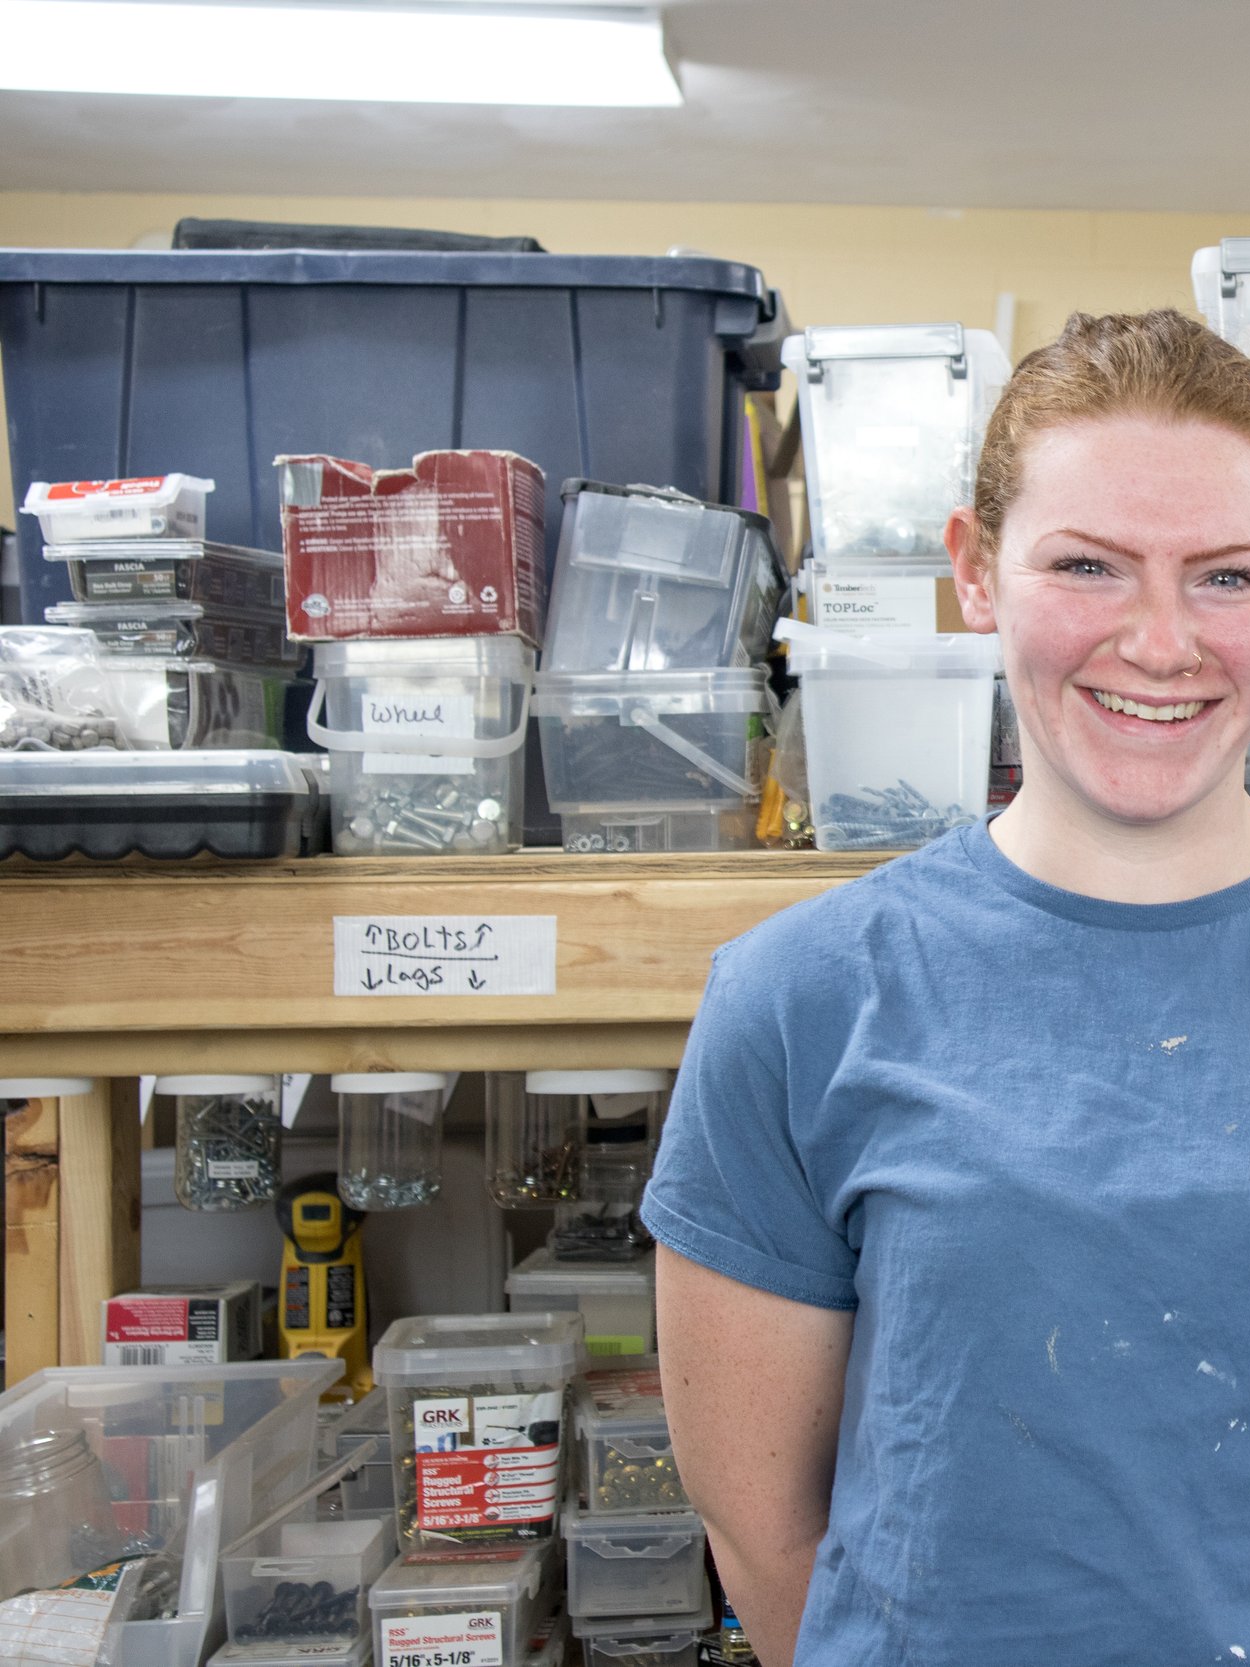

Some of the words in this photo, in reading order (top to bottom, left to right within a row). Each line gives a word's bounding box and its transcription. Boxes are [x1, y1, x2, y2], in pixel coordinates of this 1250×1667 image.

[114, 563, 145, 572] FASCIA
[824, 603, 874, 613] TOPLoc
[117, 622, 148, 631] FASCIA
[422, 1408, 461, 1424] GRK
[422, 1476, 462, 1488] Rugged
[423, 1485, 474, 1498] Structural
[423, 1498, 462, 1508] Screws
[468, 1617, 494, 1628] GRK
[389, 1629, 406, 1637] RSS
[389, 1638, 420, 1647] Rugged
[423, 1635, 464, 1645] Structural
[466, 1633, 496, 1642] Screws
